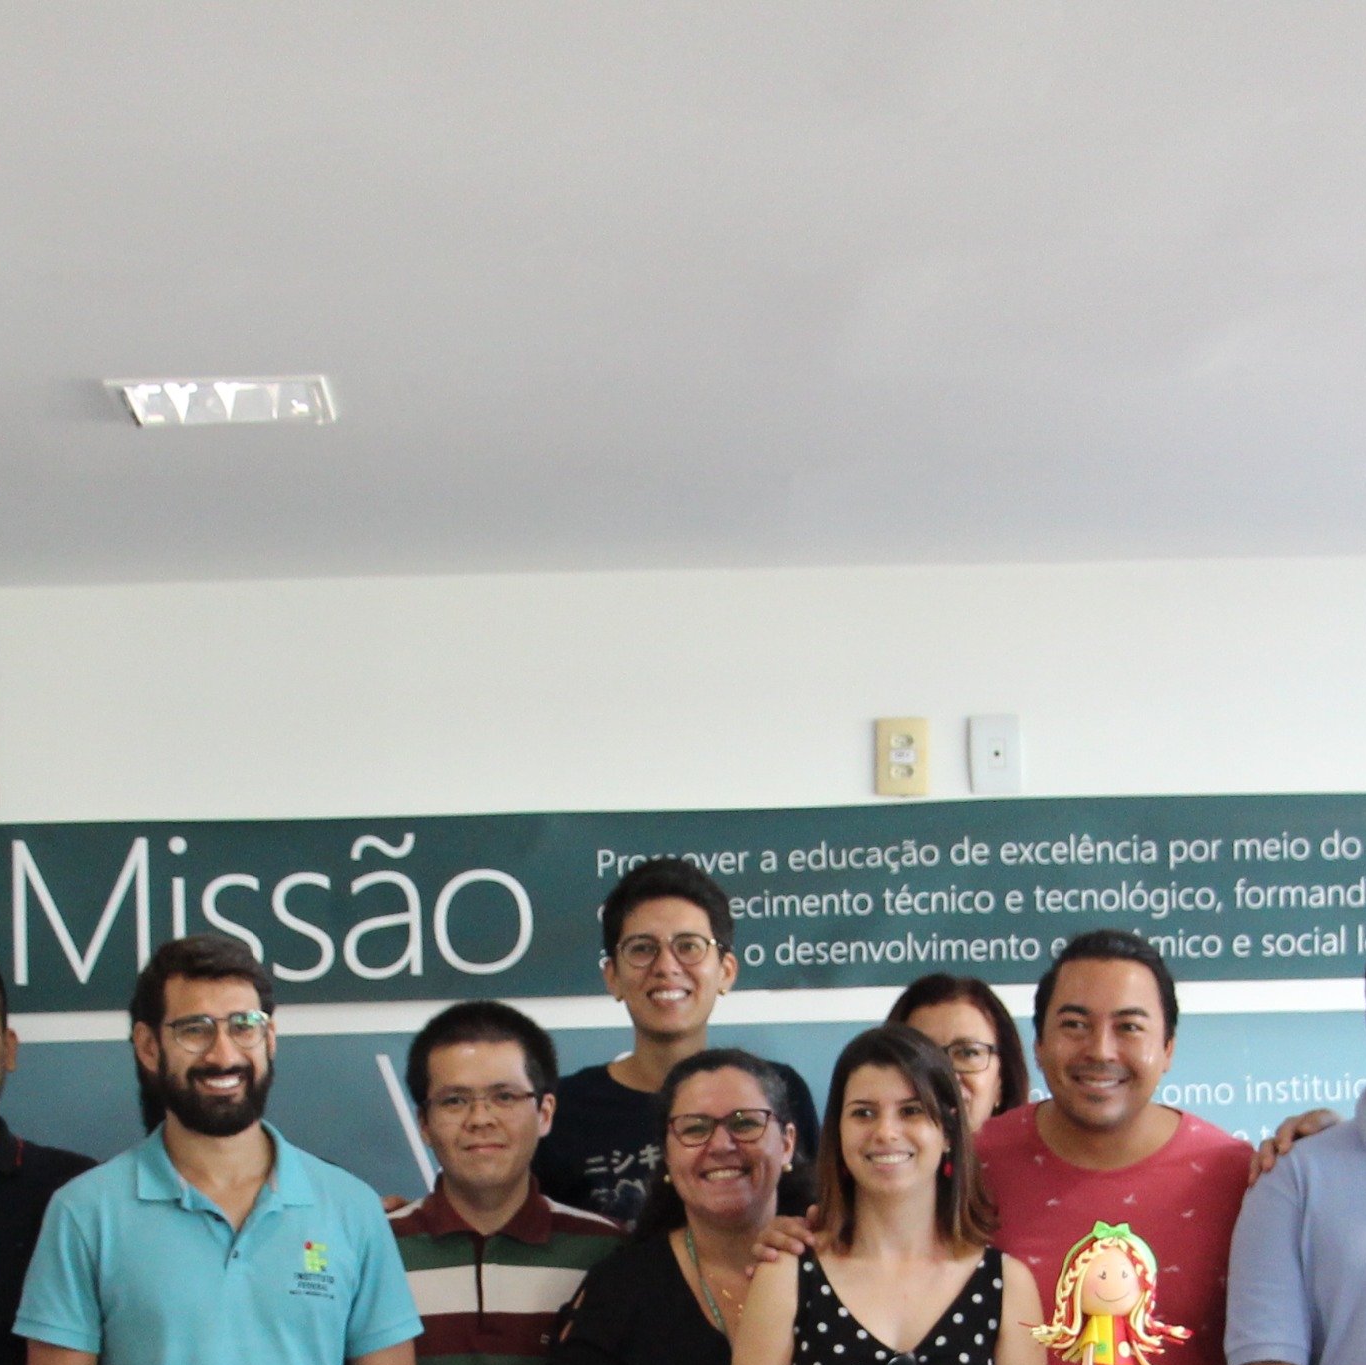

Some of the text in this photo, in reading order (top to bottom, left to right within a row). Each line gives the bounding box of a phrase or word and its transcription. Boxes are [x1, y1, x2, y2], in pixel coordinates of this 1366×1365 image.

[597, 848, 750, 878] Proover
[759, 850, 778, 874] a
[787, 839, 940, 875] educação
[950, 835, 990, 867] de
[1000, 832, 1158, 867] excelência
[1169, 838, 1222, 871] por
[1233, 831, 1310, 862] meio
[1320, 829, 1362, 861] do
[11, 833, 534, 986] Missão
[883, 883, 995, 915] técnico
[1005, 888, 1024, 913] e
[1033, 879, 1223, 920] tecnológico,
[744, 943, 766, 967] o
[774, 931, 1041, 966] desenvolvimento
[1232, 933, 1252, 958] e
[1261, 924, 1347, 956] social
[1156, 1082, 1234, 1105] omo
